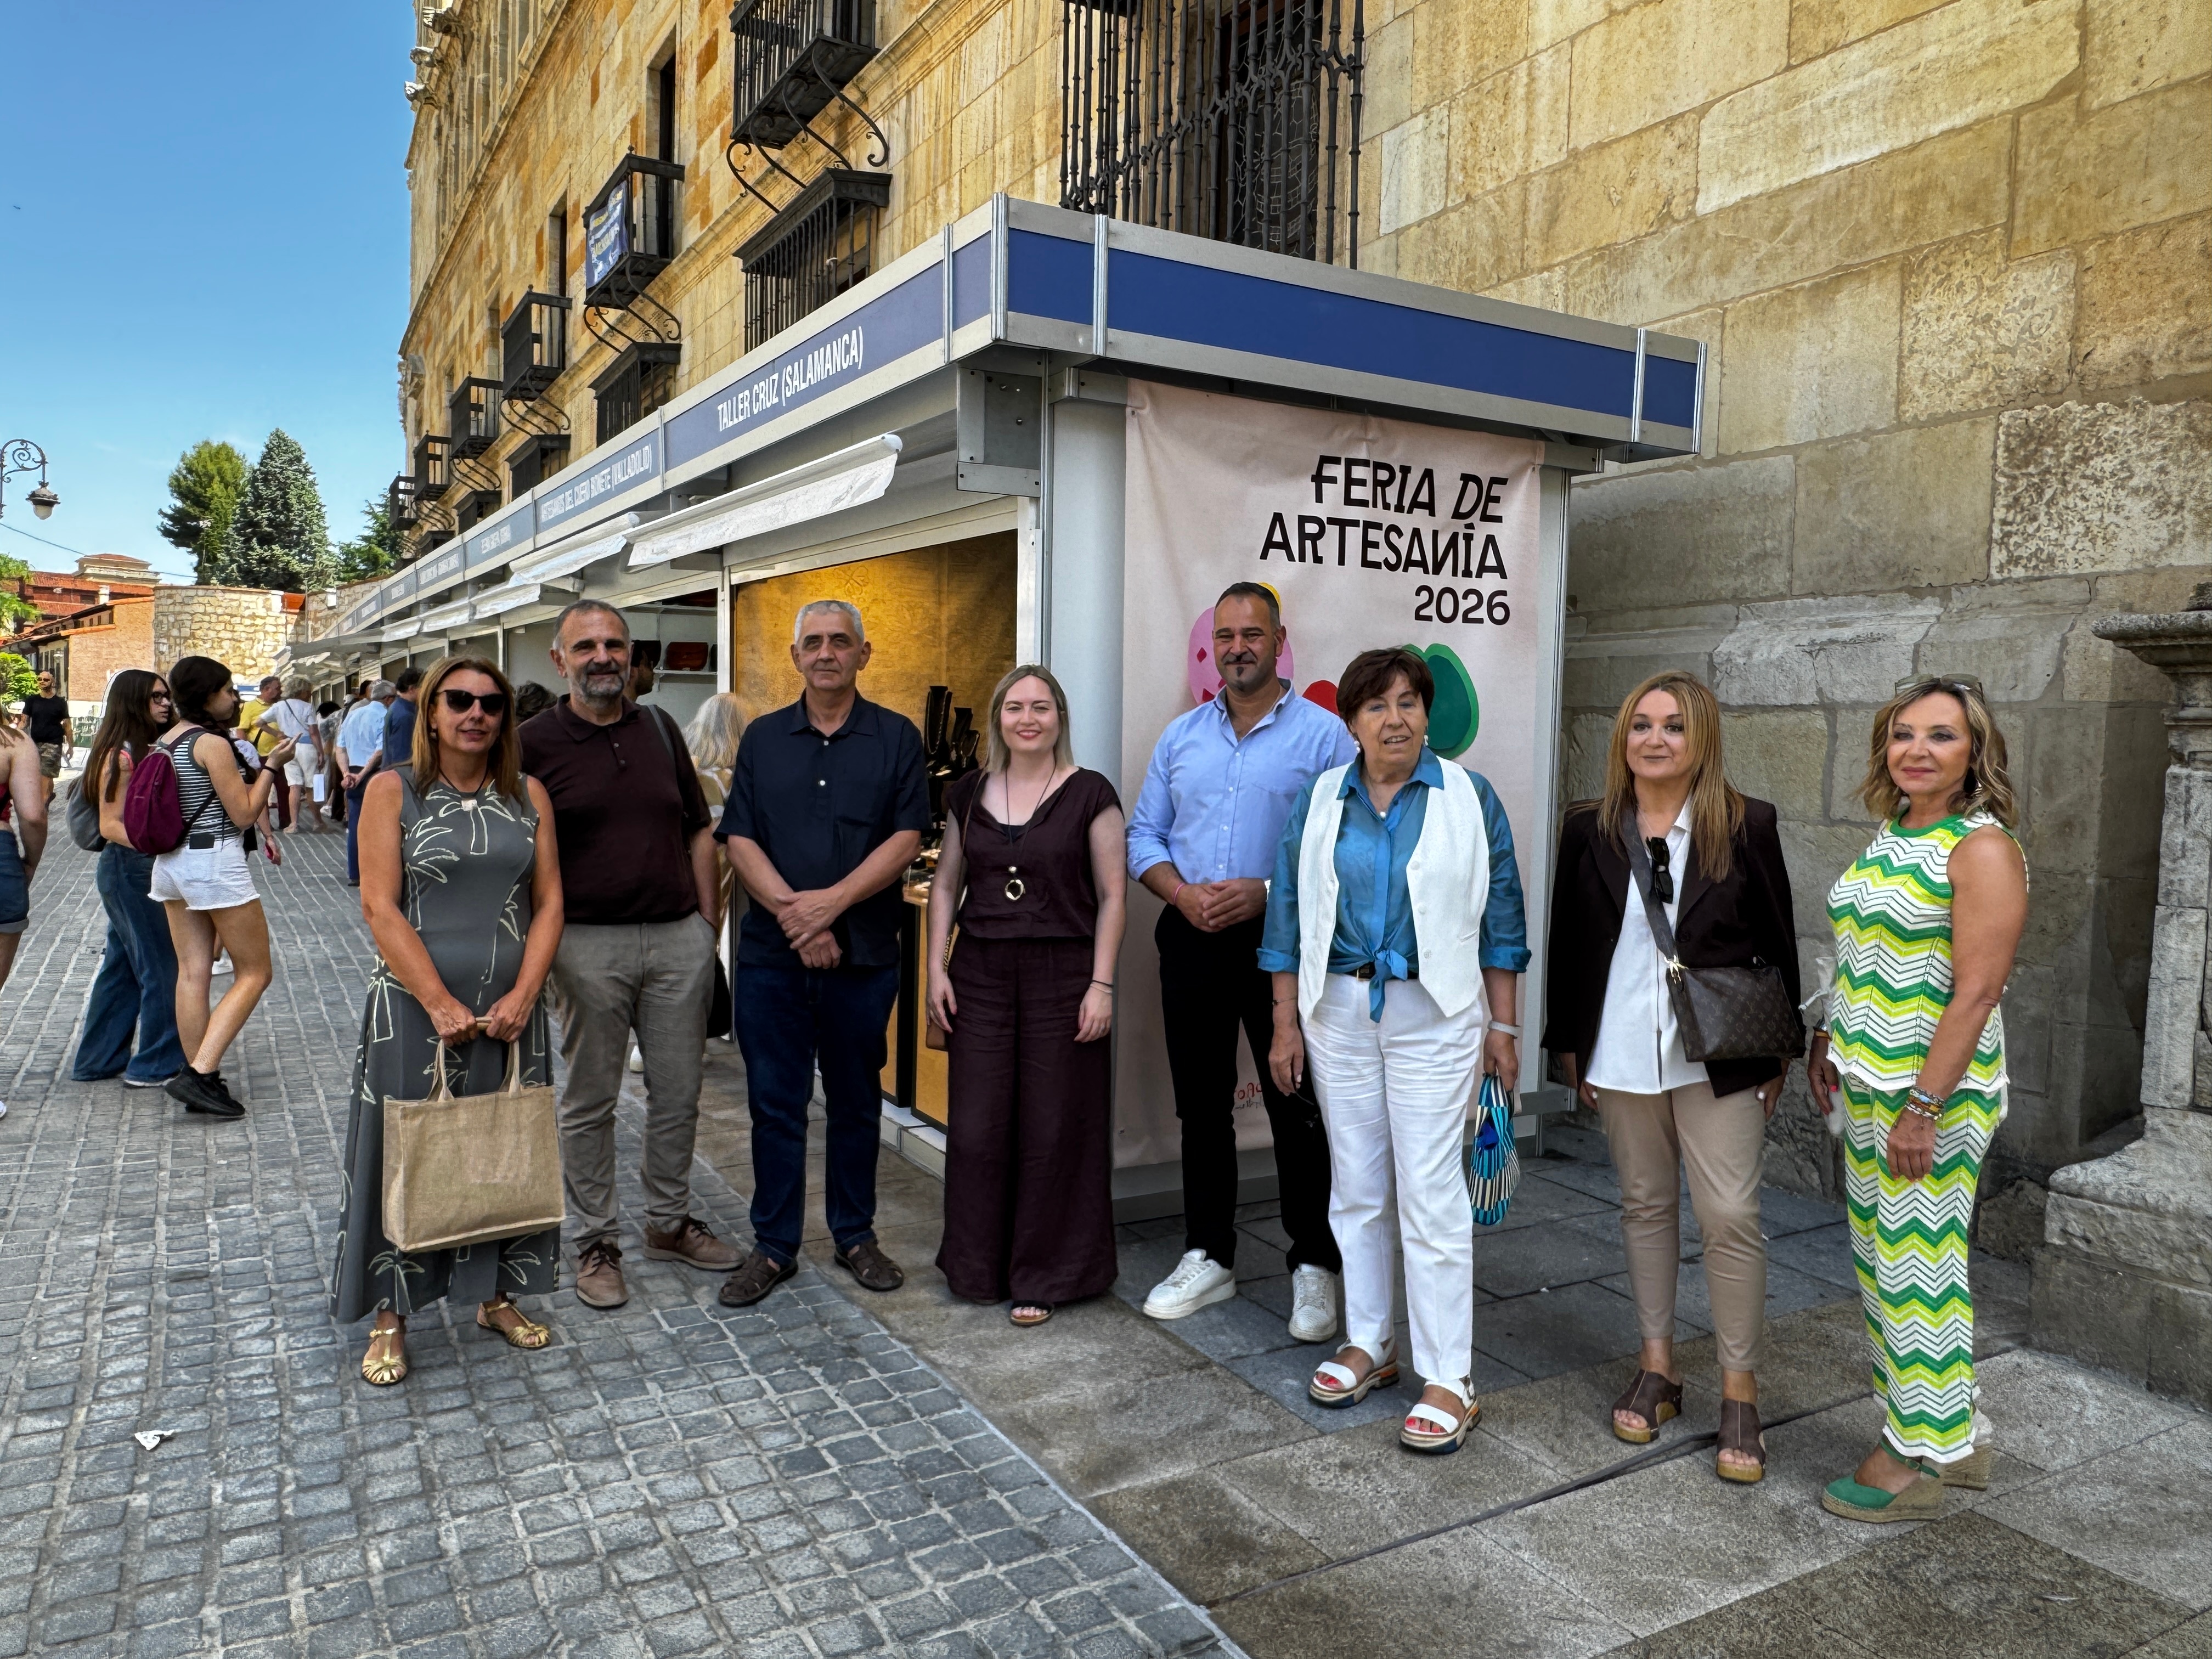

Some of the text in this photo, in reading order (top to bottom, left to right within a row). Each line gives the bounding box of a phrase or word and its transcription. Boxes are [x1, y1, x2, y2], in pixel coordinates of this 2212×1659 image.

[717, 326, 863, 432] TALLER CRUZ (SALAMANCA)
[1311, 455, 1509, 523] FERIA DE
[1259, 512, 1508, 579] ARTESANÍA
[1414, 585, 1510, 625] 2026
